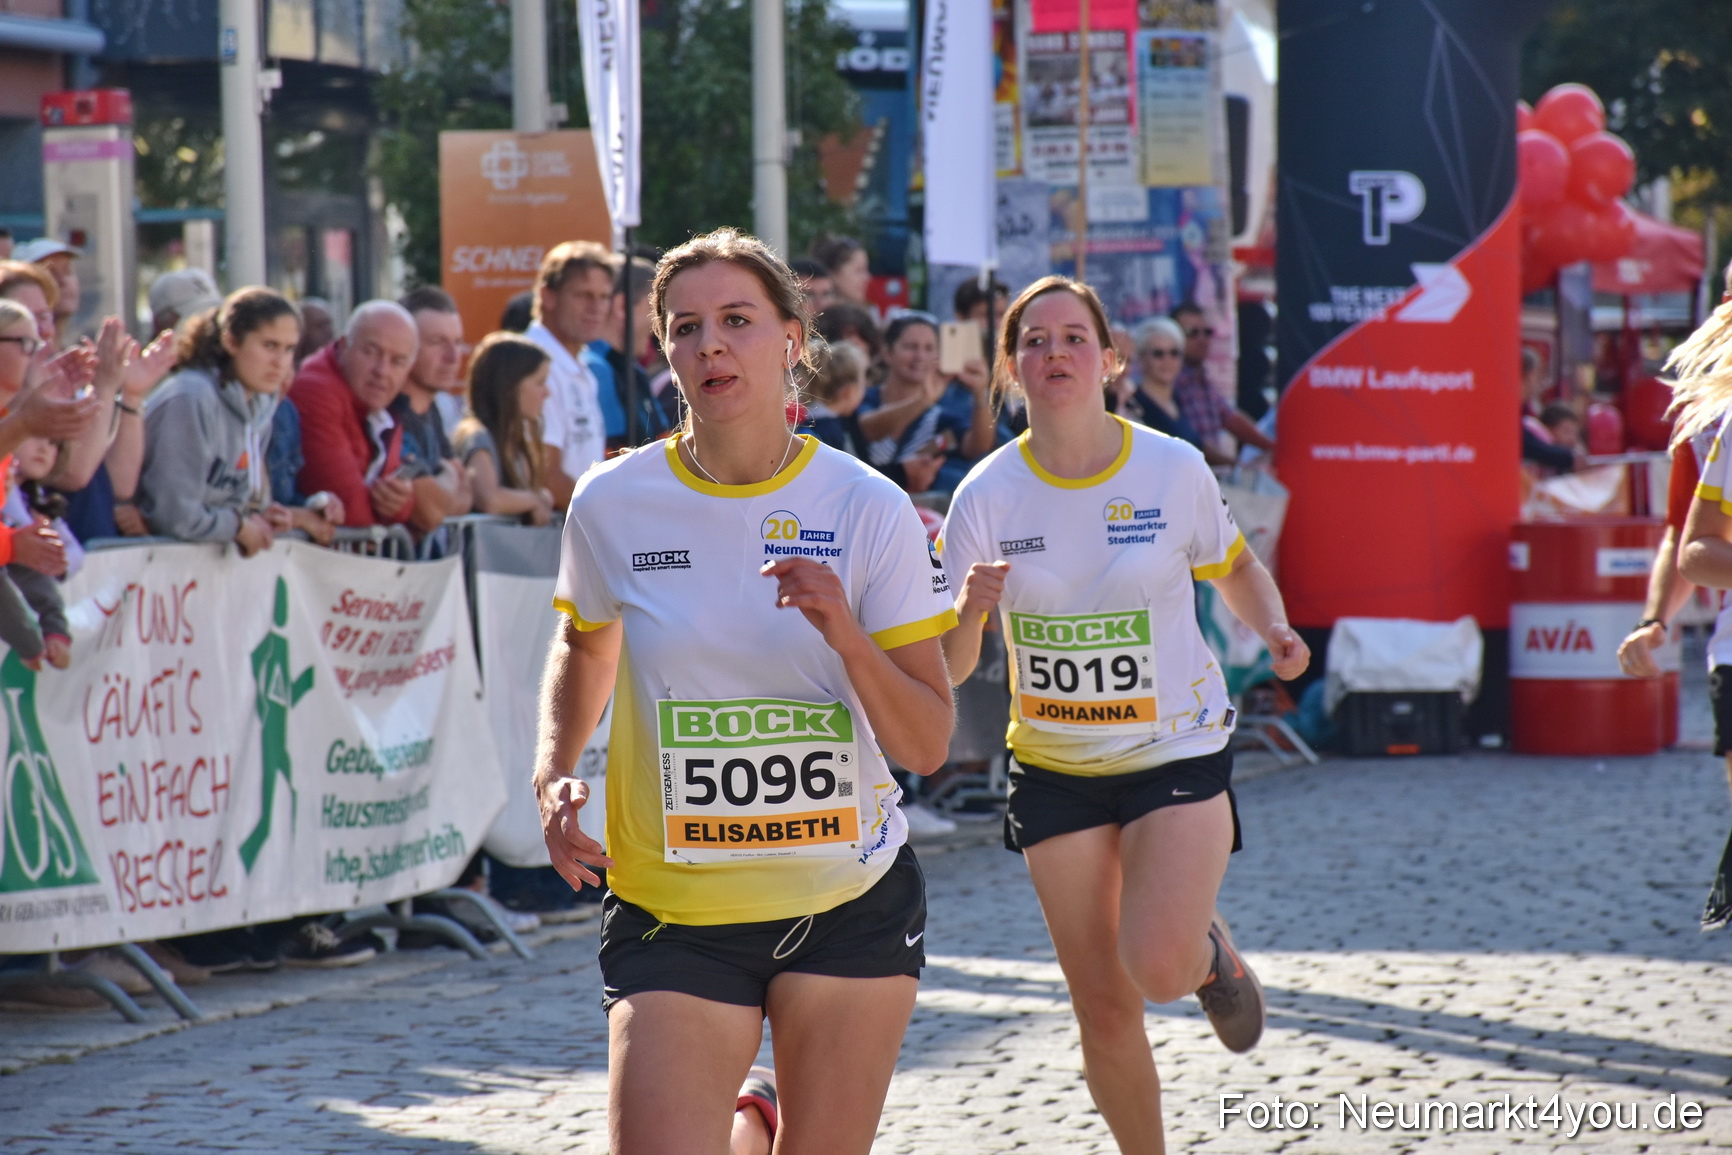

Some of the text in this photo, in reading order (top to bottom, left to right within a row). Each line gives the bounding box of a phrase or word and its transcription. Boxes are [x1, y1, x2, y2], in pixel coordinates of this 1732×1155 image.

[1309, 366, 1474, 394] BMW Laufsport
[1107, 503, 1159, 521] 20 JAHRE
[765, 519, 832, 541] 20 JAHRE
[1107, 521, 1168, 533] Neumarkter
[1000, 537, 1044, 552] BOCK
[1107, 533, 1157, 545] Stadtlauf
[632, 550, 691, 567] BOCK
[764, 544, 842, 557] Neumarkter
[137, 579, 198, 645] UNS
[1018, 614, 1141, 647] BOCK
[1029, 654, 1139, 693] 5019
[1036, 703, 1138, 721] JOHANNA
[672, 705, 840, 742] BOCK
[840, 753, 848, 763] S
[685, 751, 836, 807] 5096
[684, 816, 840, 843] ELISABETH
